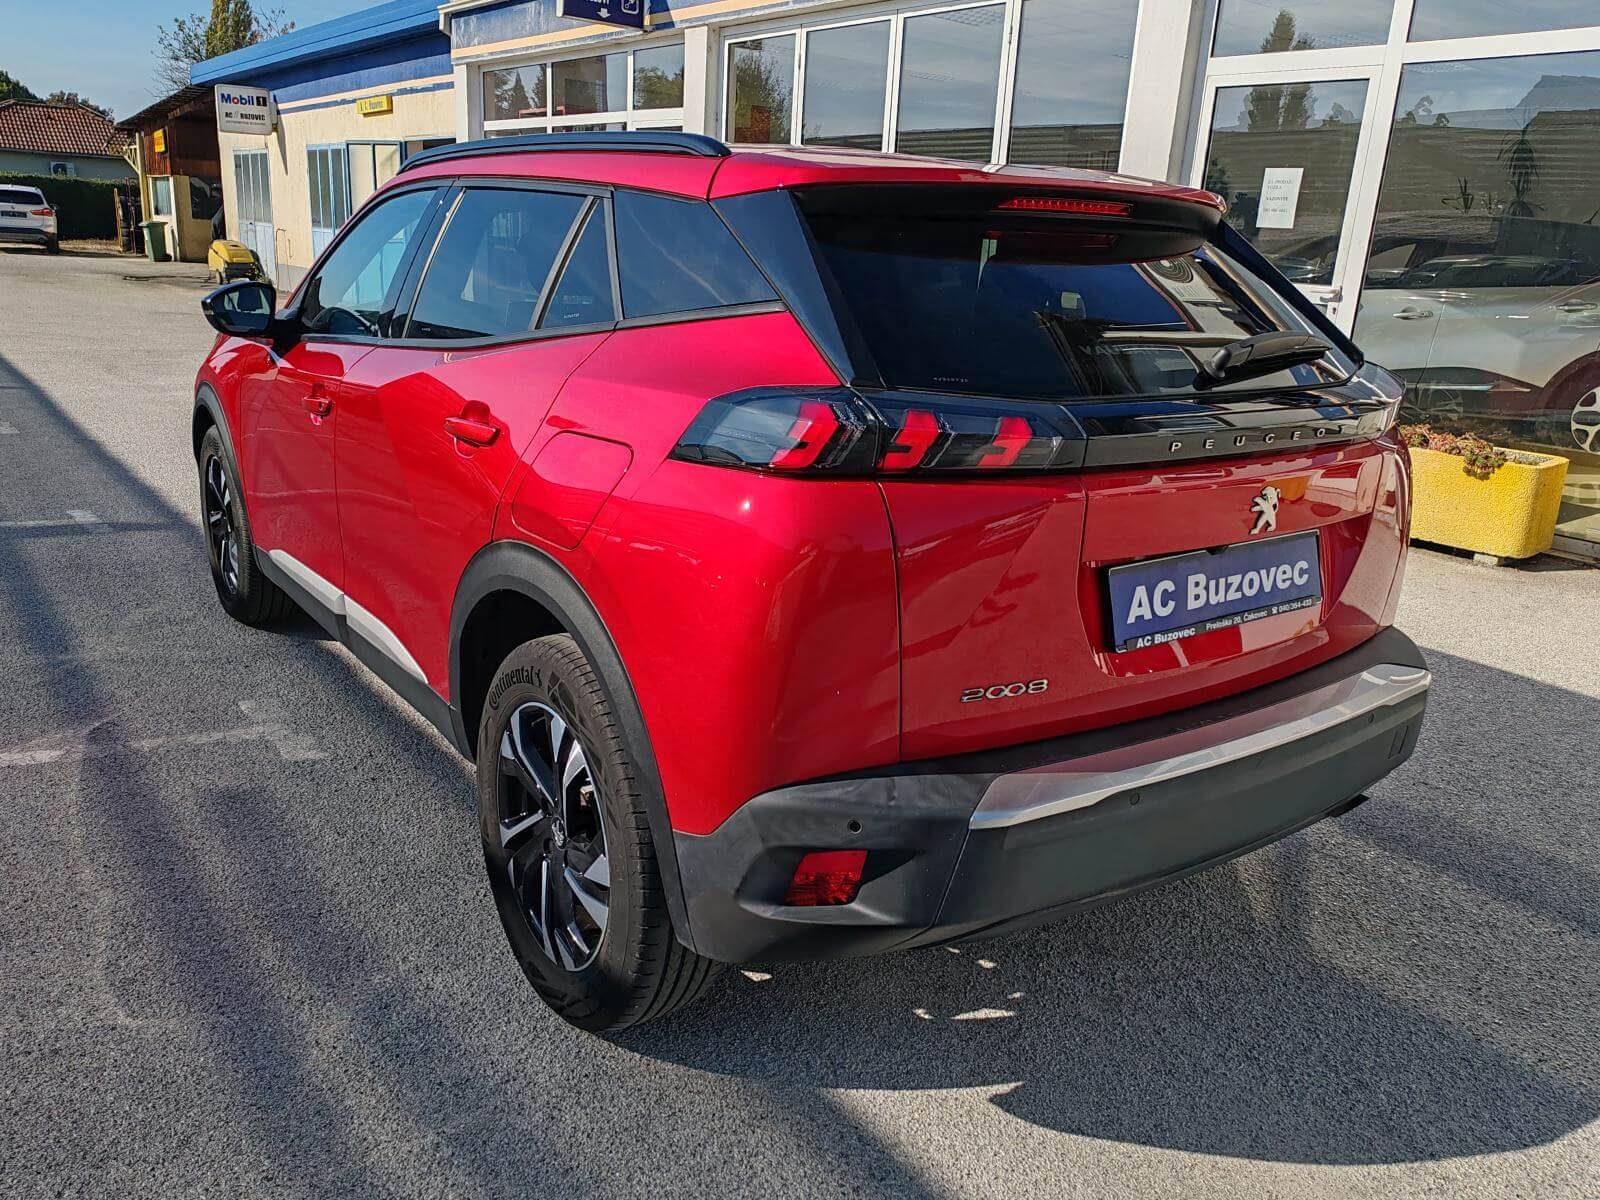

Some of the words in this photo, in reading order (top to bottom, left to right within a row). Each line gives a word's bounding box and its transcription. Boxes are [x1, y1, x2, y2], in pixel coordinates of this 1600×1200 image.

[221, 93, 254, 105] Mobil
[225, 111, 233, 119] AC
[240, 113, 266, 121] BUZOVEC
[1127, 579, 1176, 624] AC
[1186, 560, 1310, 610] Buzovec
[1136, 636, 1153, 649] AC
[1154, 628, 1196, 645] Buzovec
[488, 665, 535, 711] Continental
[960, 679, 1049, 702] 2008
